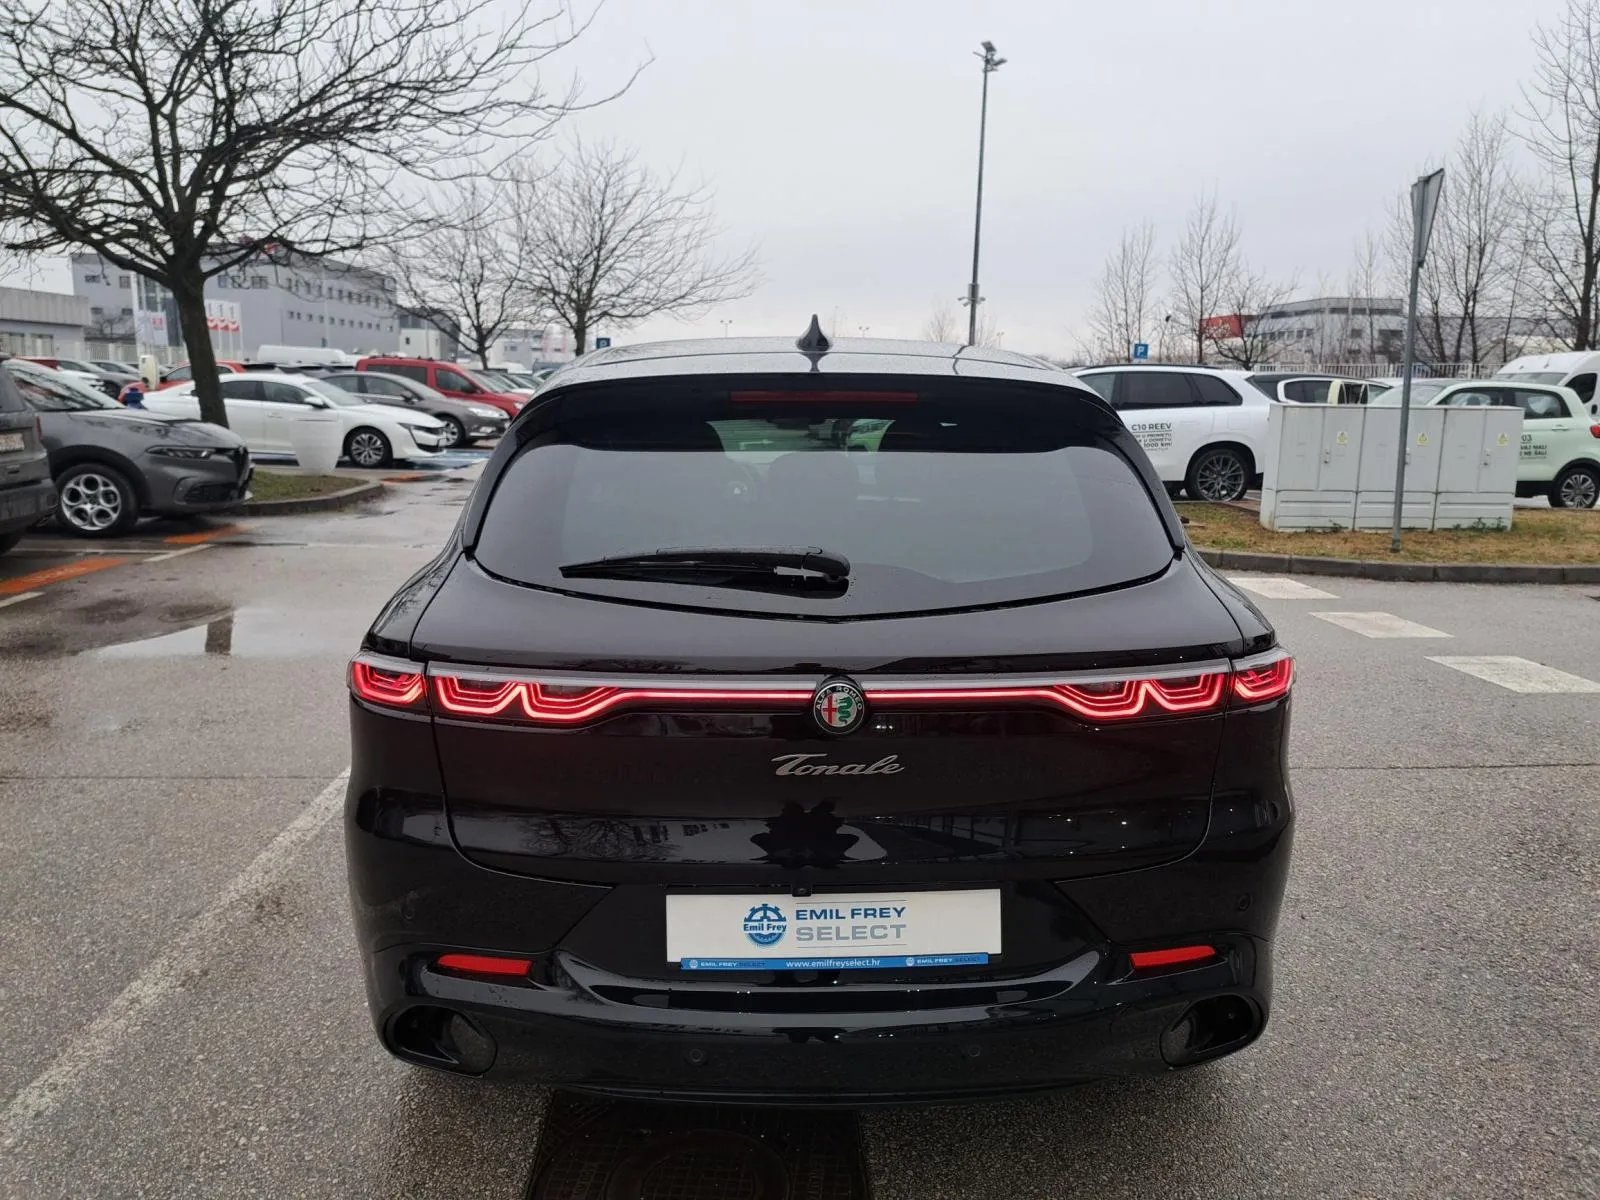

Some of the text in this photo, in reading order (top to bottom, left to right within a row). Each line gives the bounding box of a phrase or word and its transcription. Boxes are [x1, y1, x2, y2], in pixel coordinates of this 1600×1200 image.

[1137, 345, 1145, 356] P
[771, 753, 906, 776] Tonale
[795, 906, 906, 921] EMIL FREY
[743, 922, 787, 933] Emil Frey
[796, 924, 907, 942] SELECT
[785, 958, 880, 969] www.emilfreyselect.hr
